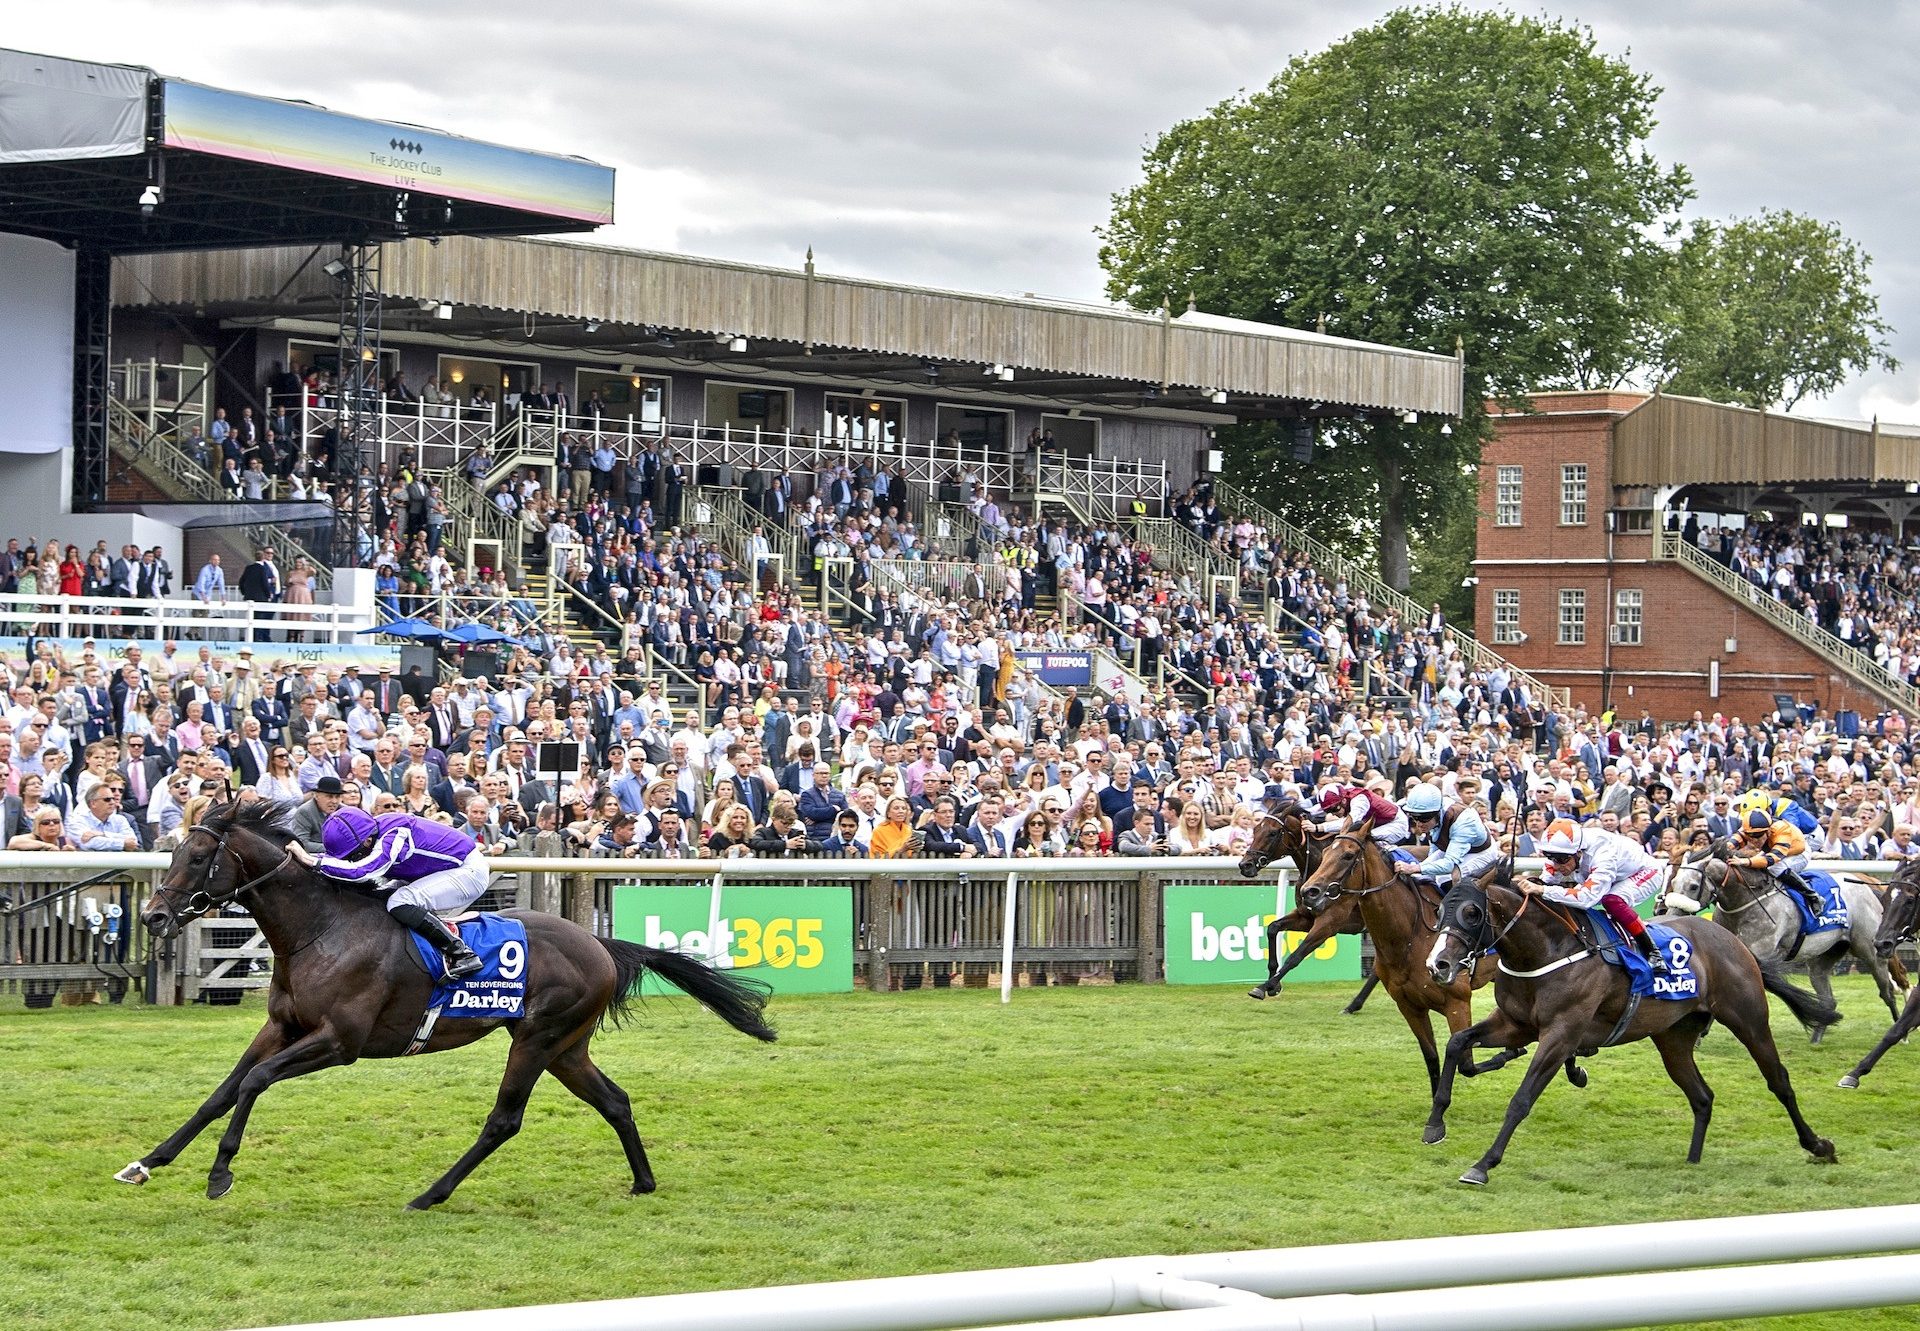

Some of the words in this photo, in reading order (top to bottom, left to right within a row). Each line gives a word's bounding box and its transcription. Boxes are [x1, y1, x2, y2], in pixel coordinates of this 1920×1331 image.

[369, 151, 386, 166] THE
[388, 156, 419, 172] JOCKEY
[421, 161, 442, 176] CLUB
[395, 175, 416, 187] LIVE
[297, 648, 324, 662] heart
[1047, 656, 1088, 668] TOTEPOOL
[645, 915, 824, 969] bet365
[1669, 937, 1690, 969] 8
[498, 940, 525, 980] 9
[465, 981, 480, 989] TEN
[480, 981, 523, 989] SOVEREIGNS
[450, 990, 523, 1013] Darley
